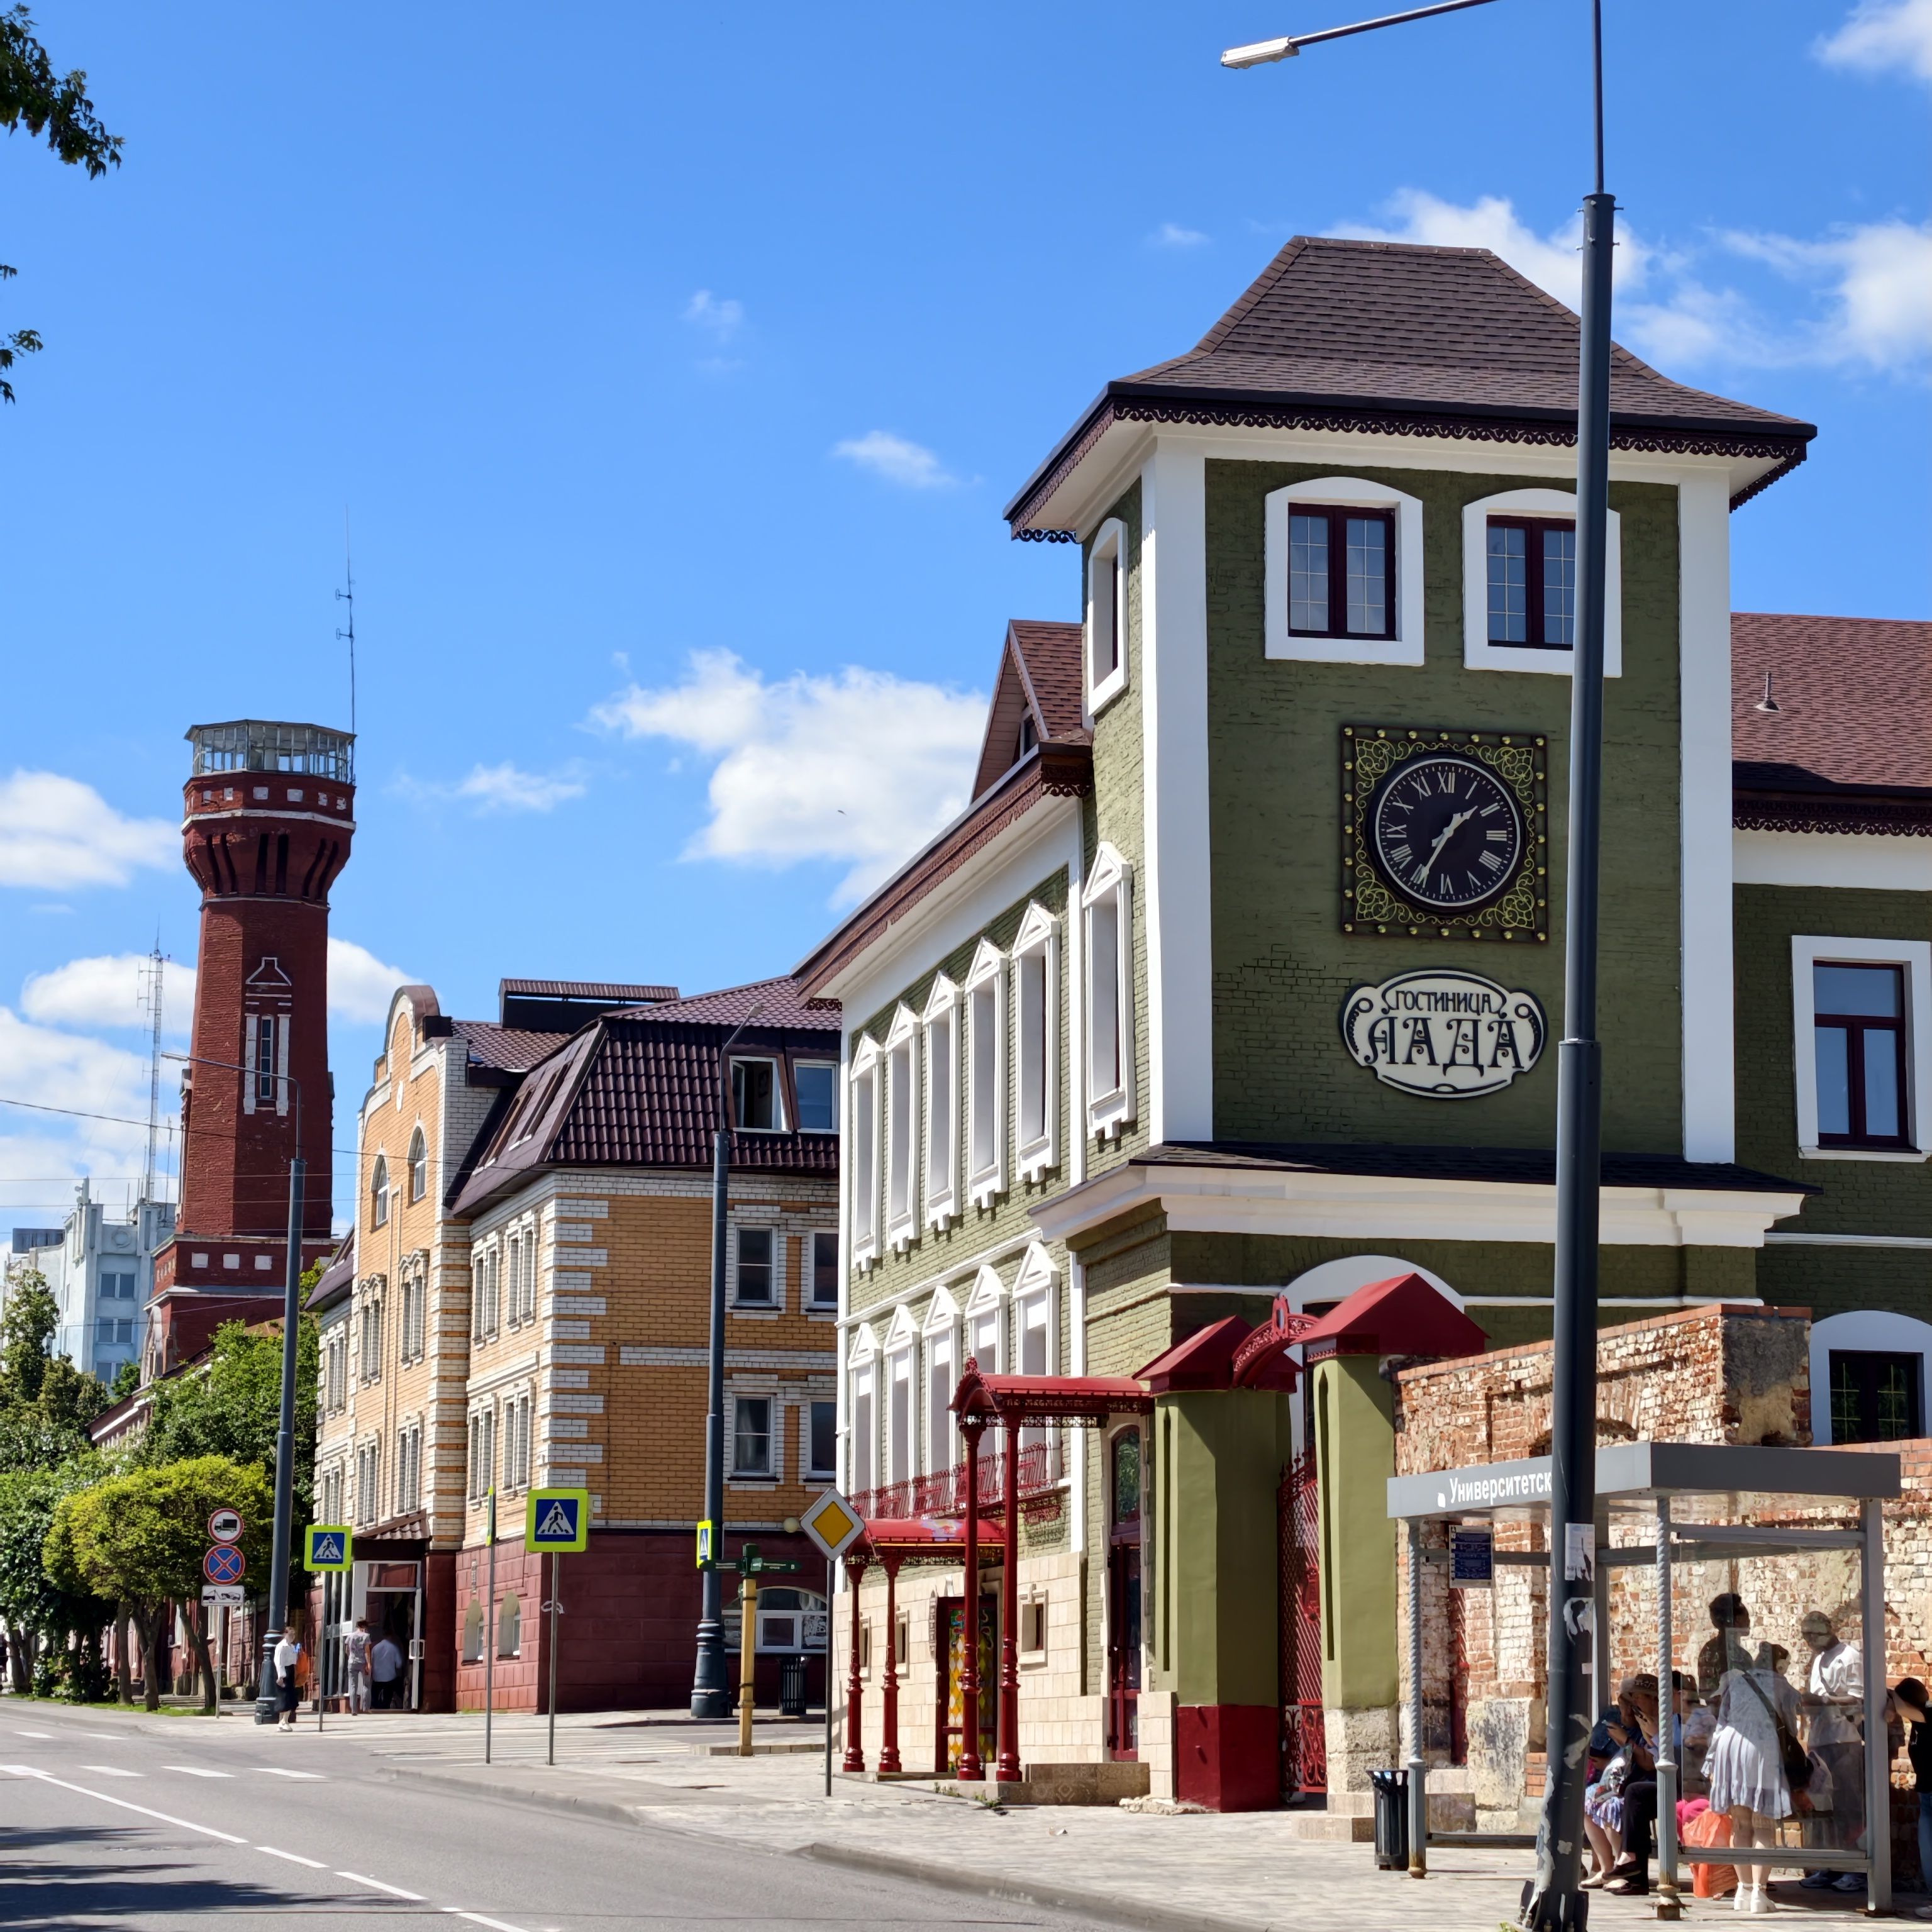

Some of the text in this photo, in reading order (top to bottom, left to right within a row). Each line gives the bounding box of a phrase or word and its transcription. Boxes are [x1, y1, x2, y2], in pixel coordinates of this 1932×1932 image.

[1411, 775, 1431, 801] XI
[1438, 772, 1455, 793] XII
[1465, 781, 1477, 799] I
[1392, 796, 1414, 815] X
[1480, 802, 1500, 816] II
[1387, 823, 1407, 838] IX
[1486, 830, 1507, 841] III
[1391, 845, 1413, 869] VIII
[1441, 874, 1453, 894] VI
[1467, 870, 1481, 889] V
[1394, 991, 1492, 1016] ГОСТИНИЦА
[1364, 1016, 1524, 1077] ЛАДА
